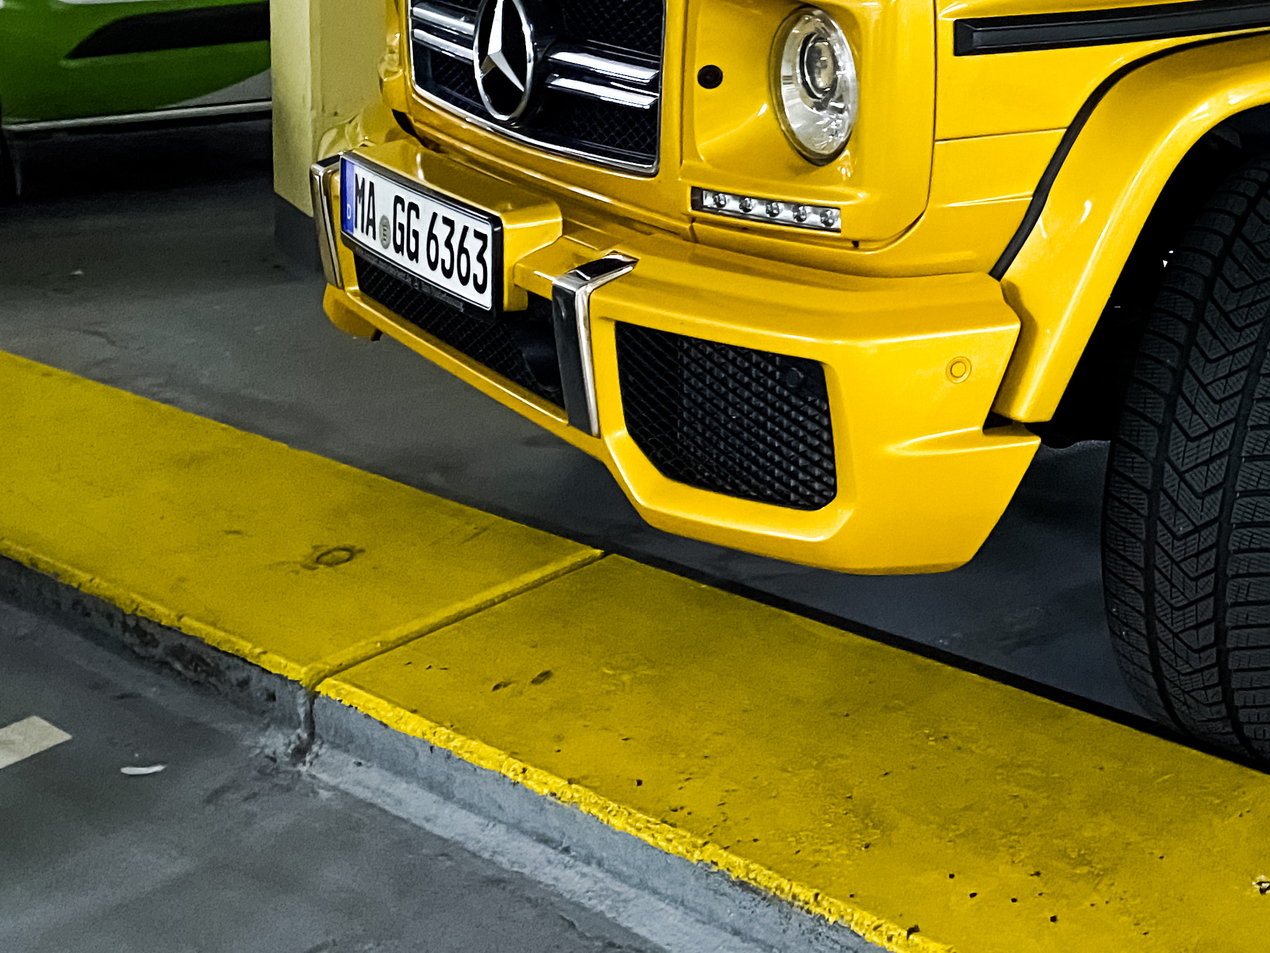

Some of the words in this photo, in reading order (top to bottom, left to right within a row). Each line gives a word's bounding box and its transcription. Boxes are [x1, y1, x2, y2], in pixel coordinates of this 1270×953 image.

[354, 173, 377, 241] MA
[393, 195, 420, 264] GG
[426, 212, 488, 295] 6363
